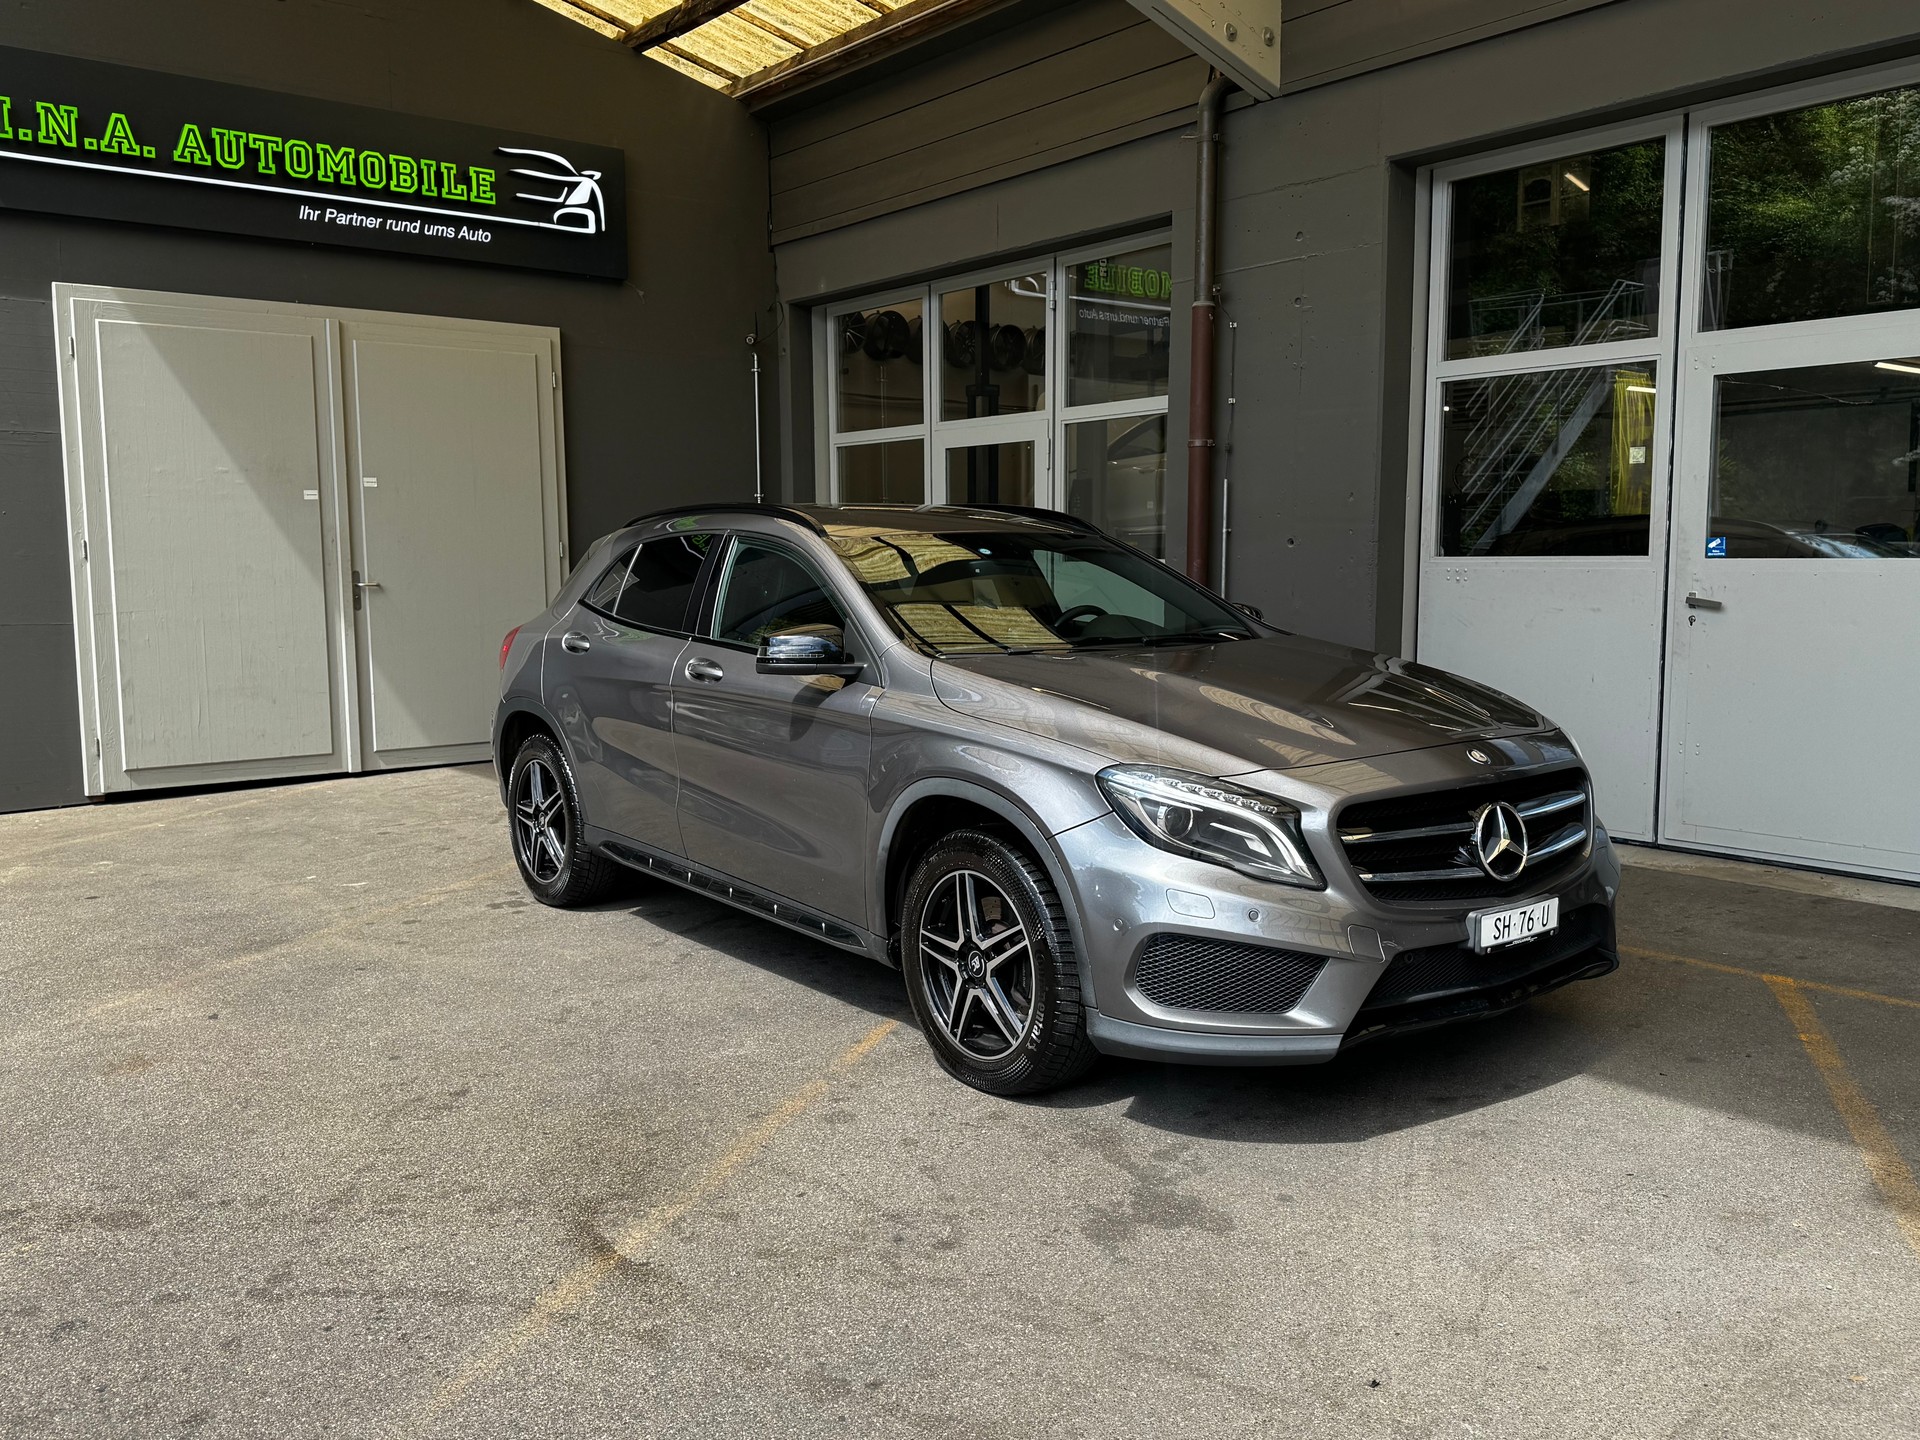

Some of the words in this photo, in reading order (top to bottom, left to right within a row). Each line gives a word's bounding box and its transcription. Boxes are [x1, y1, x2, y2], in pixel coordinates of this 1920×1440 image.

[173, 123, 496, 205] AUTOMOBILE
[299, 205, 321, 221] Ihr
[325, 208, 382, 229] Partner
[386, 219, 420, 234] rund
[424, 224, 455, 238] ums
[458, 226, 492, 243] Auto
